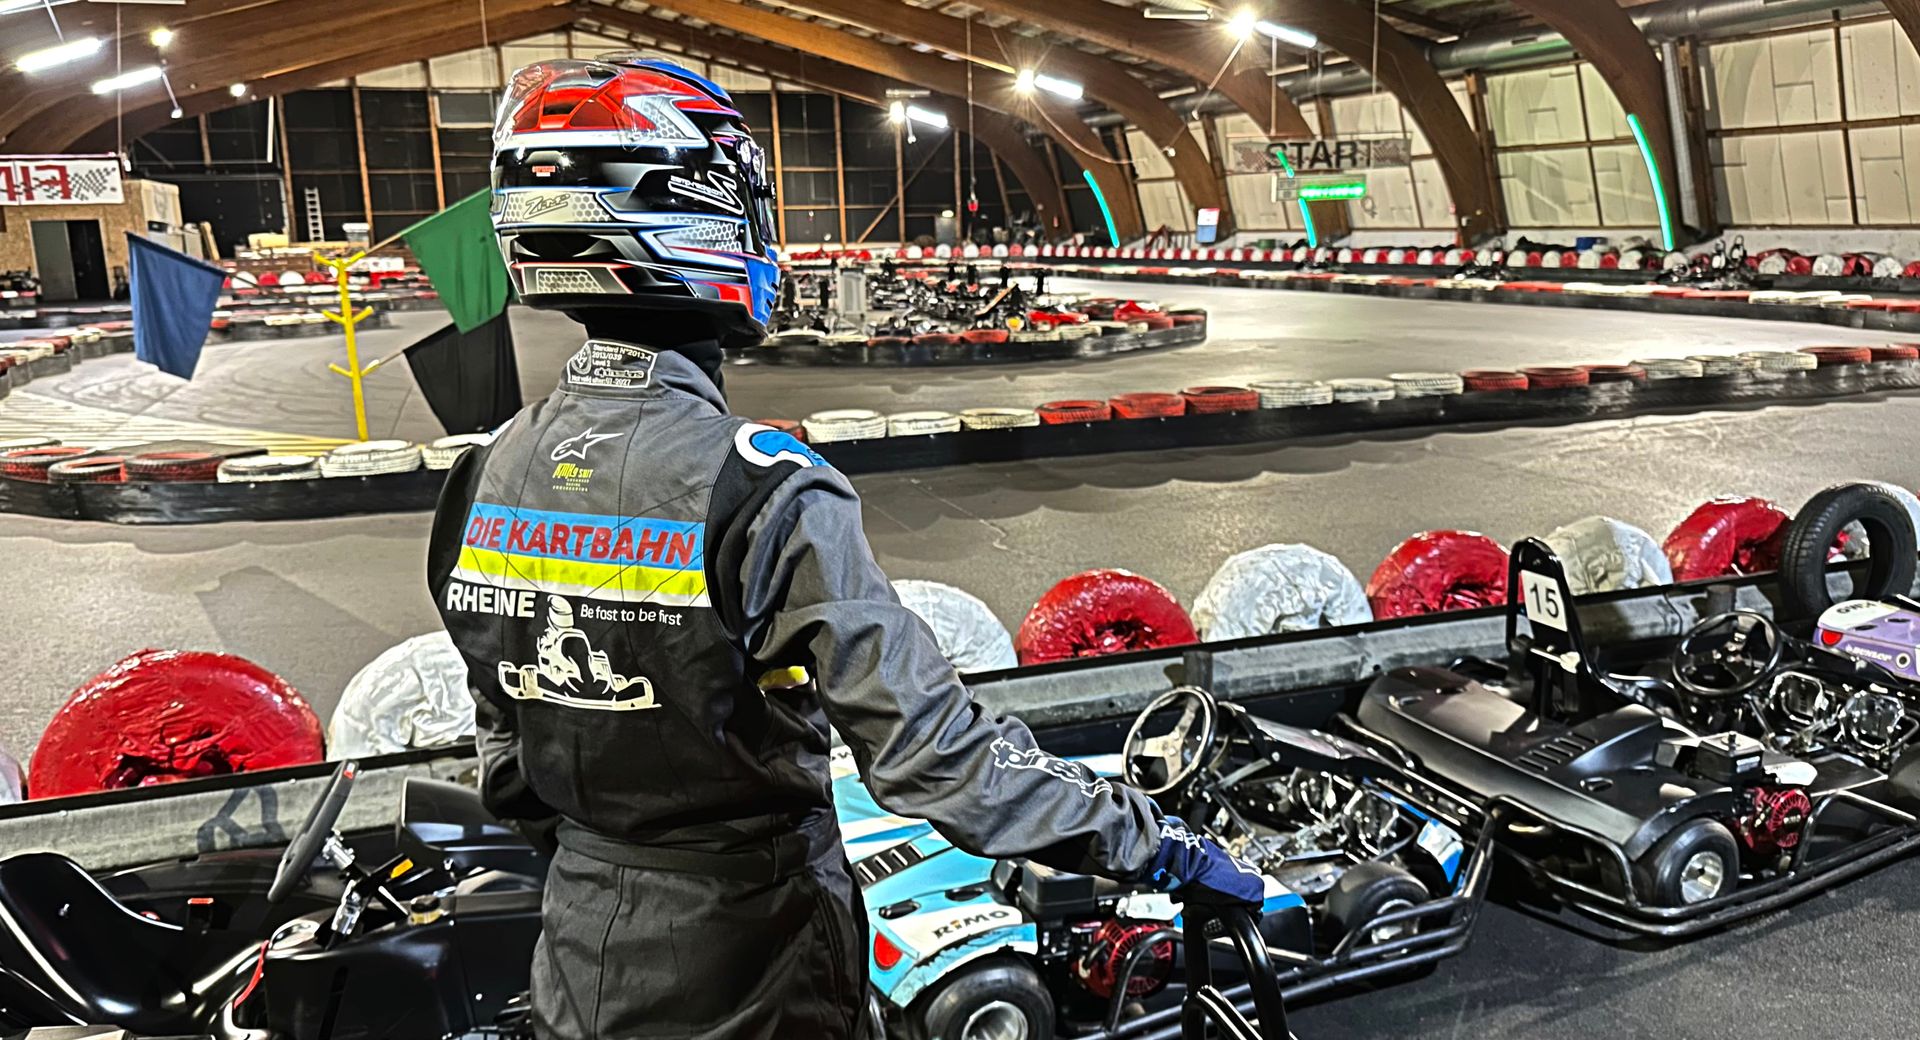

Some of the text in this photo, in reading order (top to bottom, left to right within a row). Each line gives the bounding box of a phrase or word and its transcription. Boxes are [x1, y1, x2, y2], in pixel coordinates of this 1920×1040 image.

[1266, 141, 1371, 169] START
[466, 516, 696, 566] DIE KARTBAHN
[447, 582, 536, 618] RHEINE
[580, 603, 682, 626] Be fast to be first
[1530, 582, 1559, 619] 15
